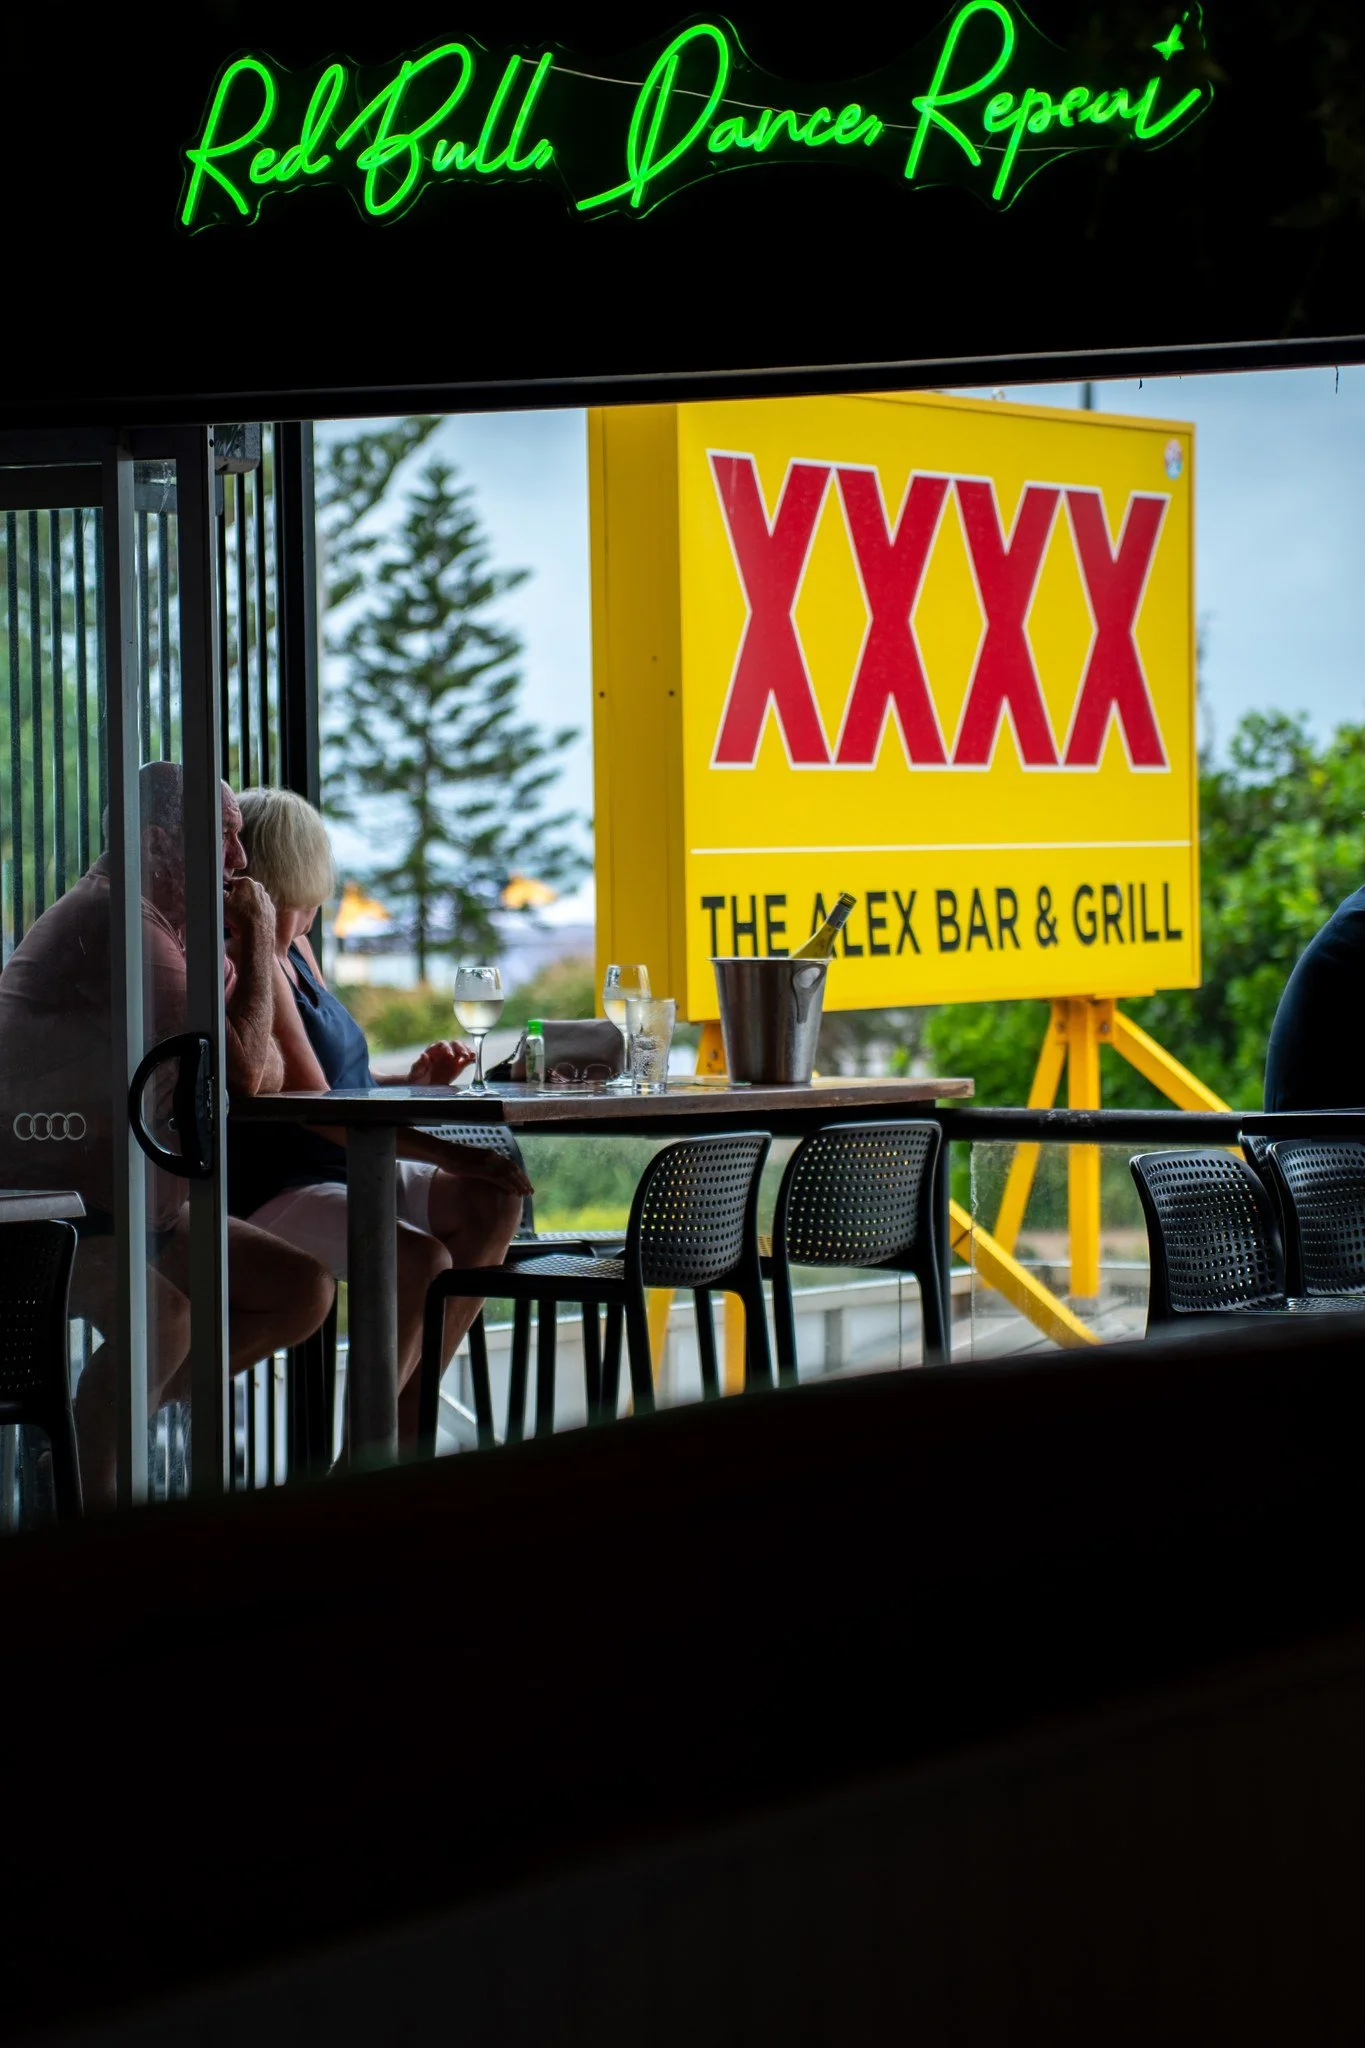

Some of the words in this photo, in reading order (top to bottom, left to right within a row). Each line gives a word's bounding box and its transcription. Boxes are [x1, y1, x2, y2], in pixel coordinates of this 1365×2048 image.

[181, 56, 345, 226] Red
[705, 448, 1172, 774] XXXX
[700, 893, 791, 959] THE
[935, 886, 1021, 953] BAR
[1034, 884, 1059, 949] &
[1072, 881, 1184, 946] GRILL
